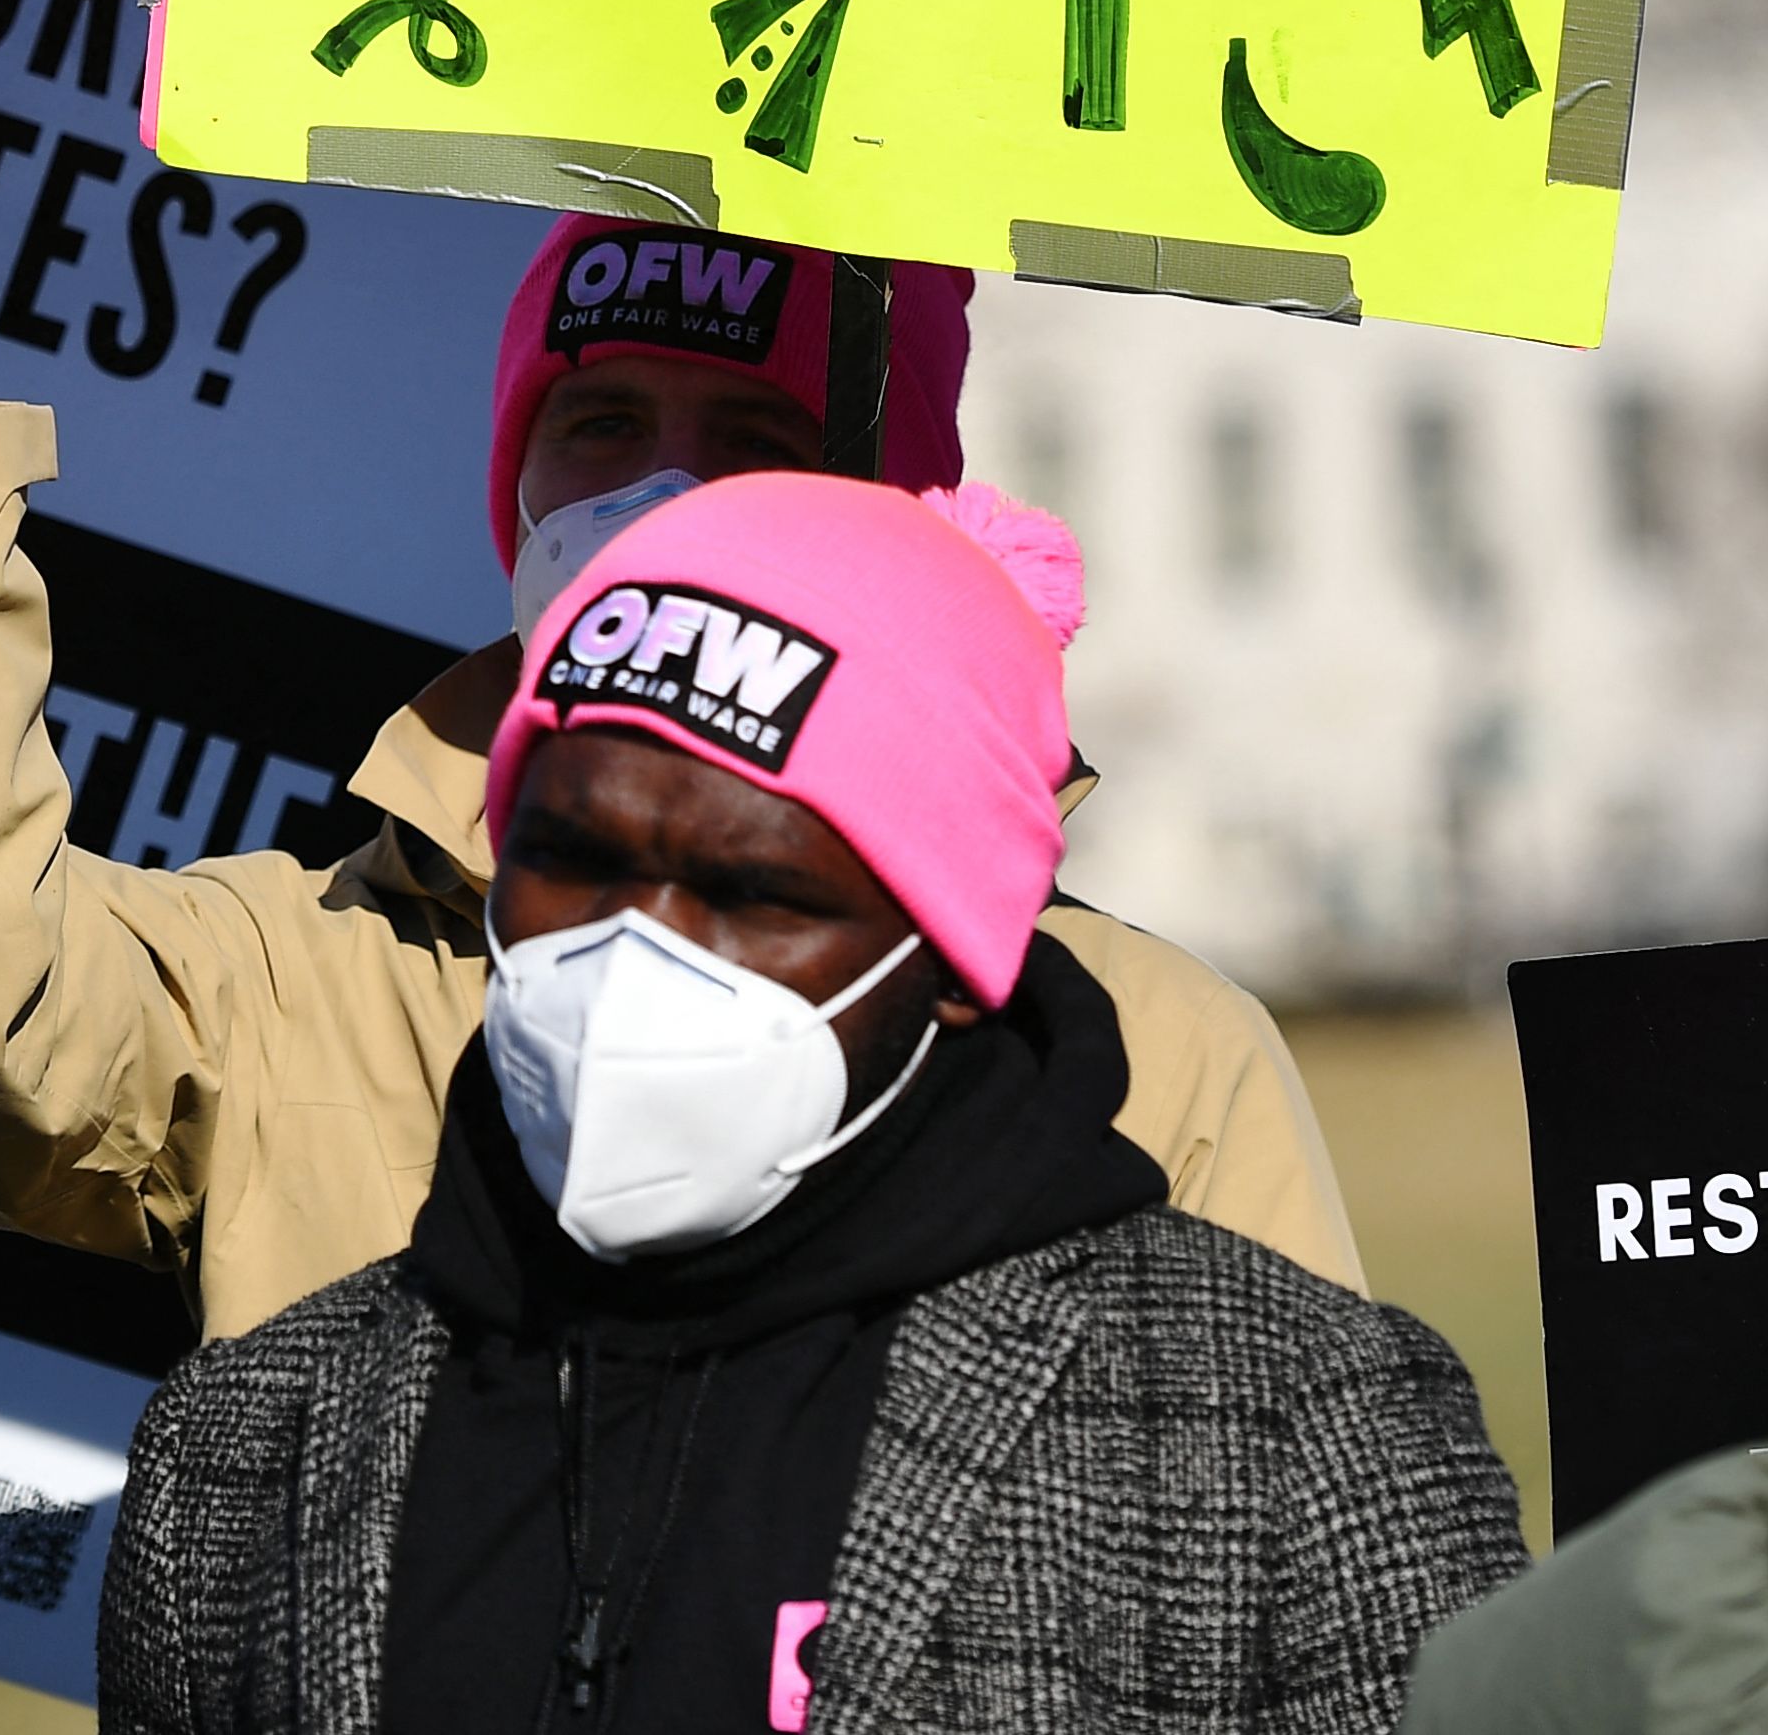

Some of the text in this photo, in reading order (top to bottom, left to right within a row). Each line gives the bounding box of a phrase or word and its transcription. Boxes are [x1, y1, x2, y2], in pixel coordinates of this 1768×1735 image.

[567, 240, 778, 317] OFW
[558, 307, 760, 345] ONE FAIR WAGE
[568, 588, 823, 718] OFW
[549, 660, 782, 754] ONE FAIR WAGE
